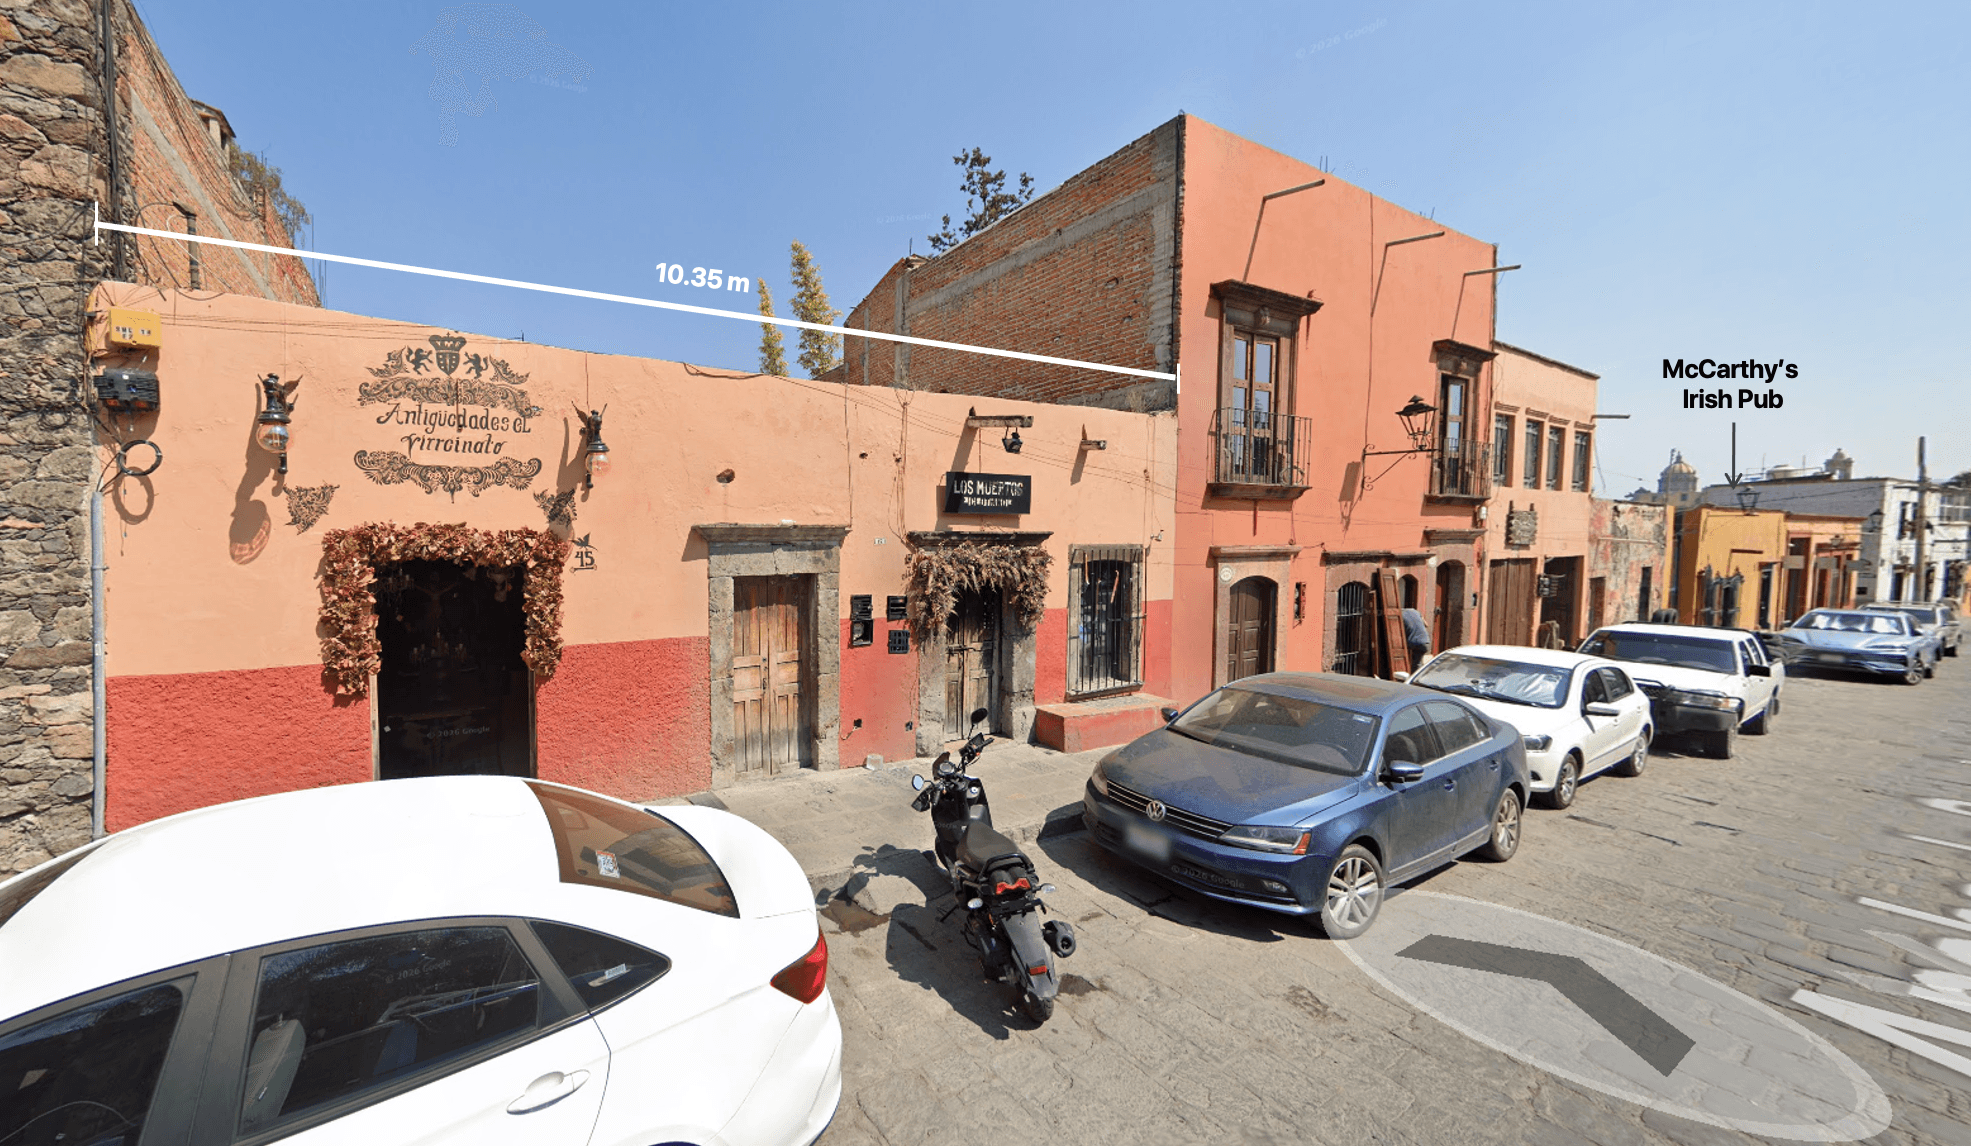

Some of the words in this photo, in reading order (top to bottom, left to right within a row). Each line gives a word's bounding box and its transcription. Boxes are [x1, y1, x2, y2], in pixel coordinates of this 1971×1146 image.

[953, 480, 974, 495] LOS
[976, 480, 1024, 497] MUERTOS
[574, 550, 596, 567] 45
